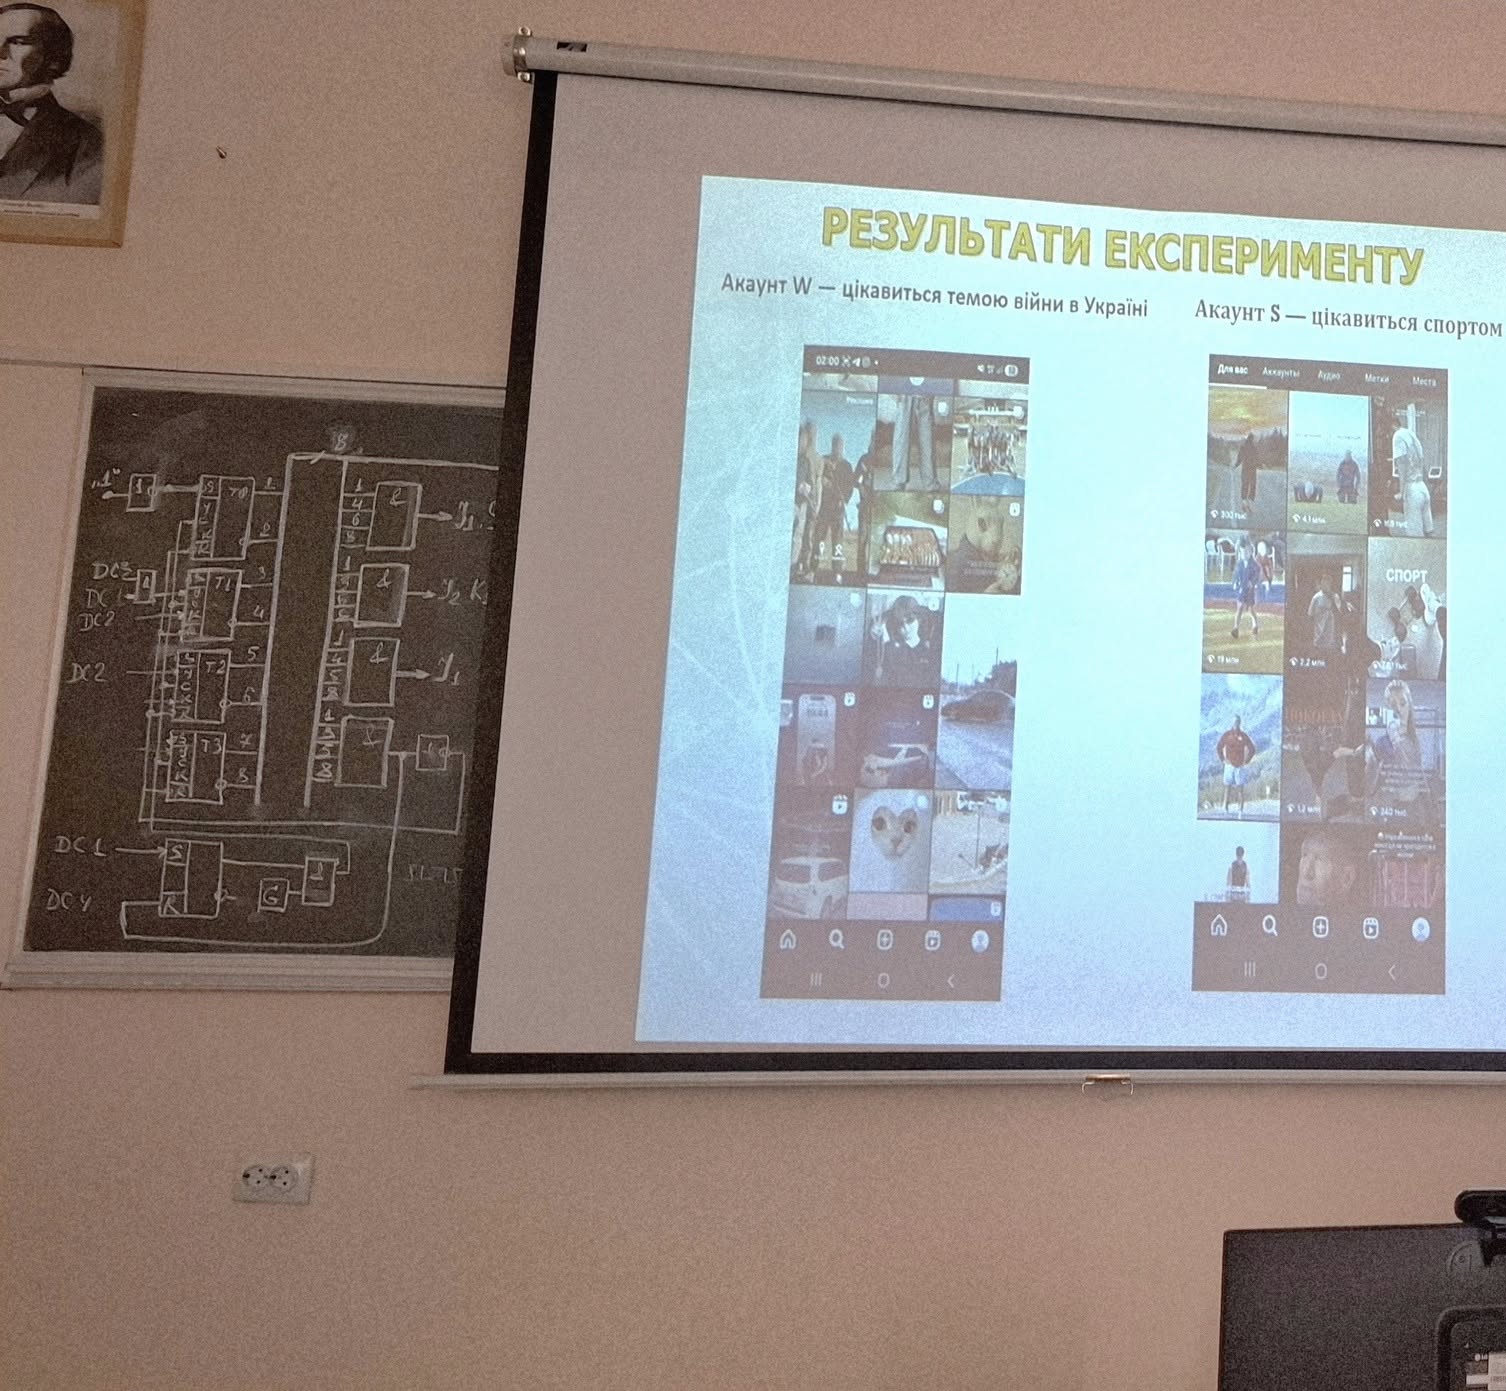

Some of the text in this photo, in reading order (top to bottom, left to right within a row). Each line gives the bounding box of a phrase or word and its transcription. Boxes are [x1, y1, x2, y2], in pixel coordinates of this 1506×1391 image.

[821, 205, 1425, 286] РЕЗУЛЬТАТИ ЕКСПЕРИМЕНТУ
[721, 273, 788, 299] Акаунт
[793, 276, 812, 296] W
[842, 280, 942, 306] цікавиться
[947, 289, 1009, 309] темою
[1014, 290, 1064, 314] війни
[1069, 300, 1079, 314] в
[1084, 296, 1148, 319] Україні
[1195, 298, 1503, 340] Акаунт S цікавиться спортом
[816, 355, 840, 367] 02:00
[1218, 363, 1248, 375] Для вас
[1262, 367, 1300, 380] Аккаунты
[1365, 373, 1390, 384] Метки
[1413, 376, 1437, 387] Места
[1386, 568, 1428, 583] СПОРТ
